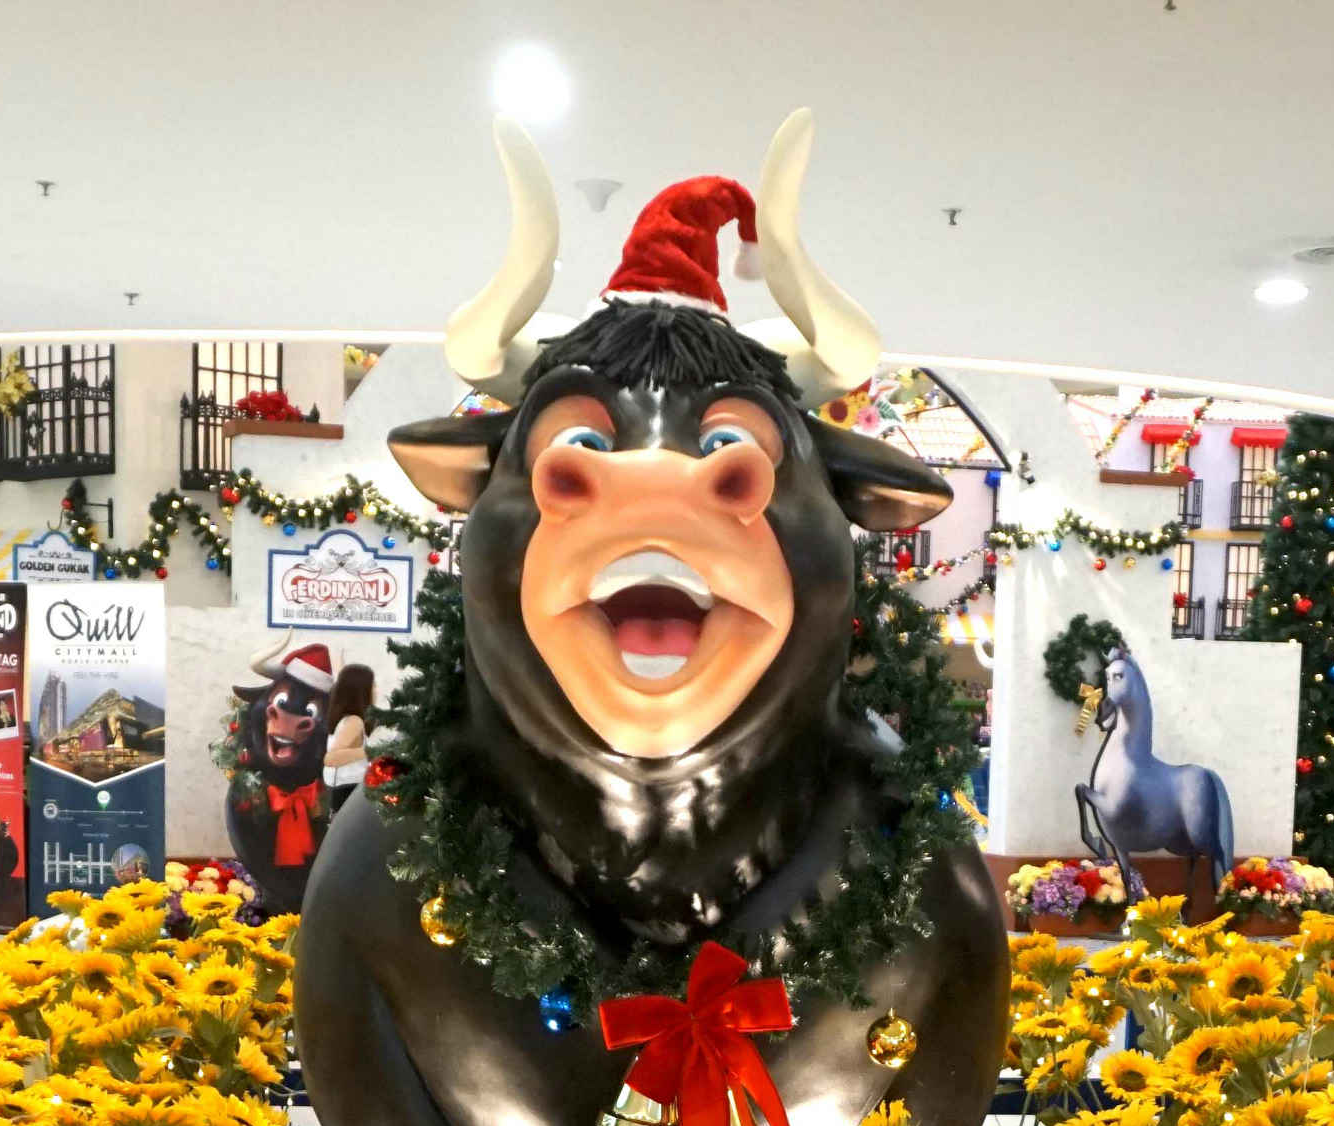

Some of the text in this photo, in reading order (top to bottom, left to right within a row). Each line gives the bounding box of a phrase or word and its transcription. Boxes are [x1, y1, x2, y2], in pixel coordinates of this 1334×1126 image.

[19, 561, 55, 572] GOLDEN
[282, 563, 398, 607] FERDINAND
[46, 599, 146, 642] Quill
[54, 647, 138, 656] CITYMALL
